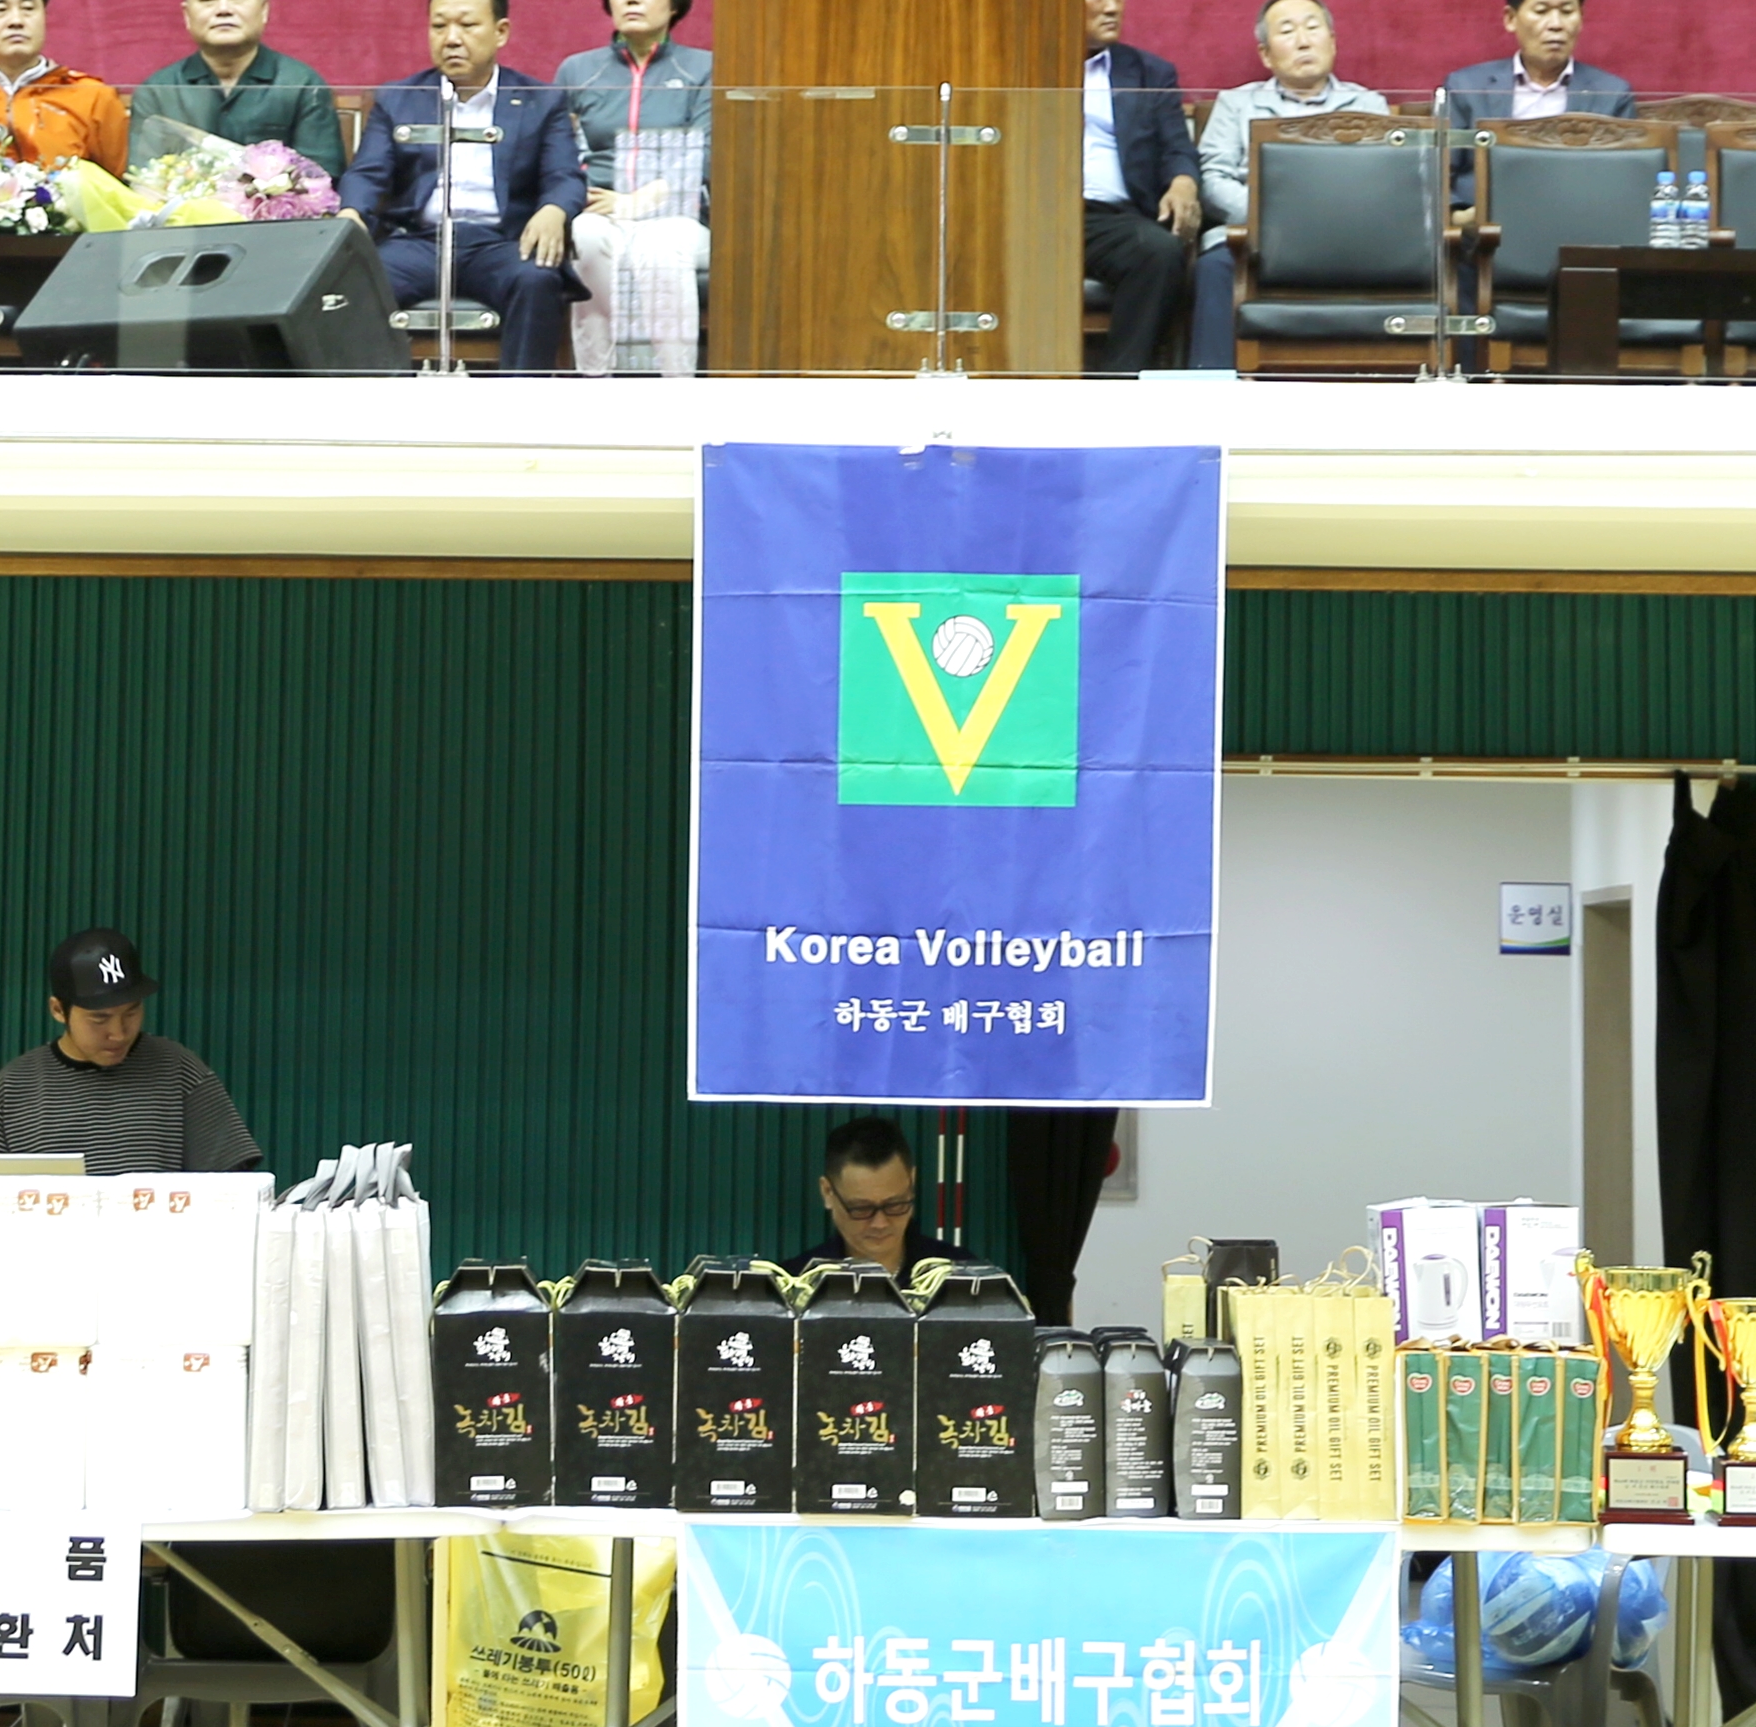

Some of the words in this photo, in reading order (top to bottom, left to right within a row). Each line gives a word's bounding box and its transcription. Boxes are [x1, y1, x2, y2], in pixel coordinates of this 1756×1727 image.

[863, 602, 1062, 796] V
[1507, 903, 1564, 926] 운영실
[765, 925, 901, 966] Korea
[915, 928, 1145, 973] Volleyball
[833, 998, 932, 1035] 하동군
[941, 998, 1066, 1036] 배구협회
[1253, 1336, 1265, 1355] SET
[1291, 1336, 1303, 1355] SET
[1254, 1358, 1265, 1381] GIFT
[1292, 1358, 1303, 1381] GIFT
[1255, 1384, 1266, 1401] OIL
[1293, 1384, 1304, 1401] OIL
[1327, 1364, 1340, 1413] PREMIUM
[1366, 1364, 1379, 1413] PREMIUM
[452, 1402, 528, 1439] 녹차김
[576, 1403, 651, 1439] 녹차김
[694, 1407, 769, 1443] 녹차김
[816, 1411, 891, 1447] 녹차김
[936, 1414, 1011, 1450] 녹차김
[1255, 1404, 1267, 1453] PREMIUM
[1293, 1404, 1305, 1453] PREMIUM
[1328, 1416, 1341, 1434] OIL
[1367, 1416, 1380, 1434] OIL
[1328, 1436, 1341, 1459] GIFT
[1367, 1436, 1380, 1459] GIFT
[1329, 1462, 1343, 1482] SET
[1368, 1462, 1382, 1482] SET
[812, 1634, 1261, 1727] 하동군배구협회
